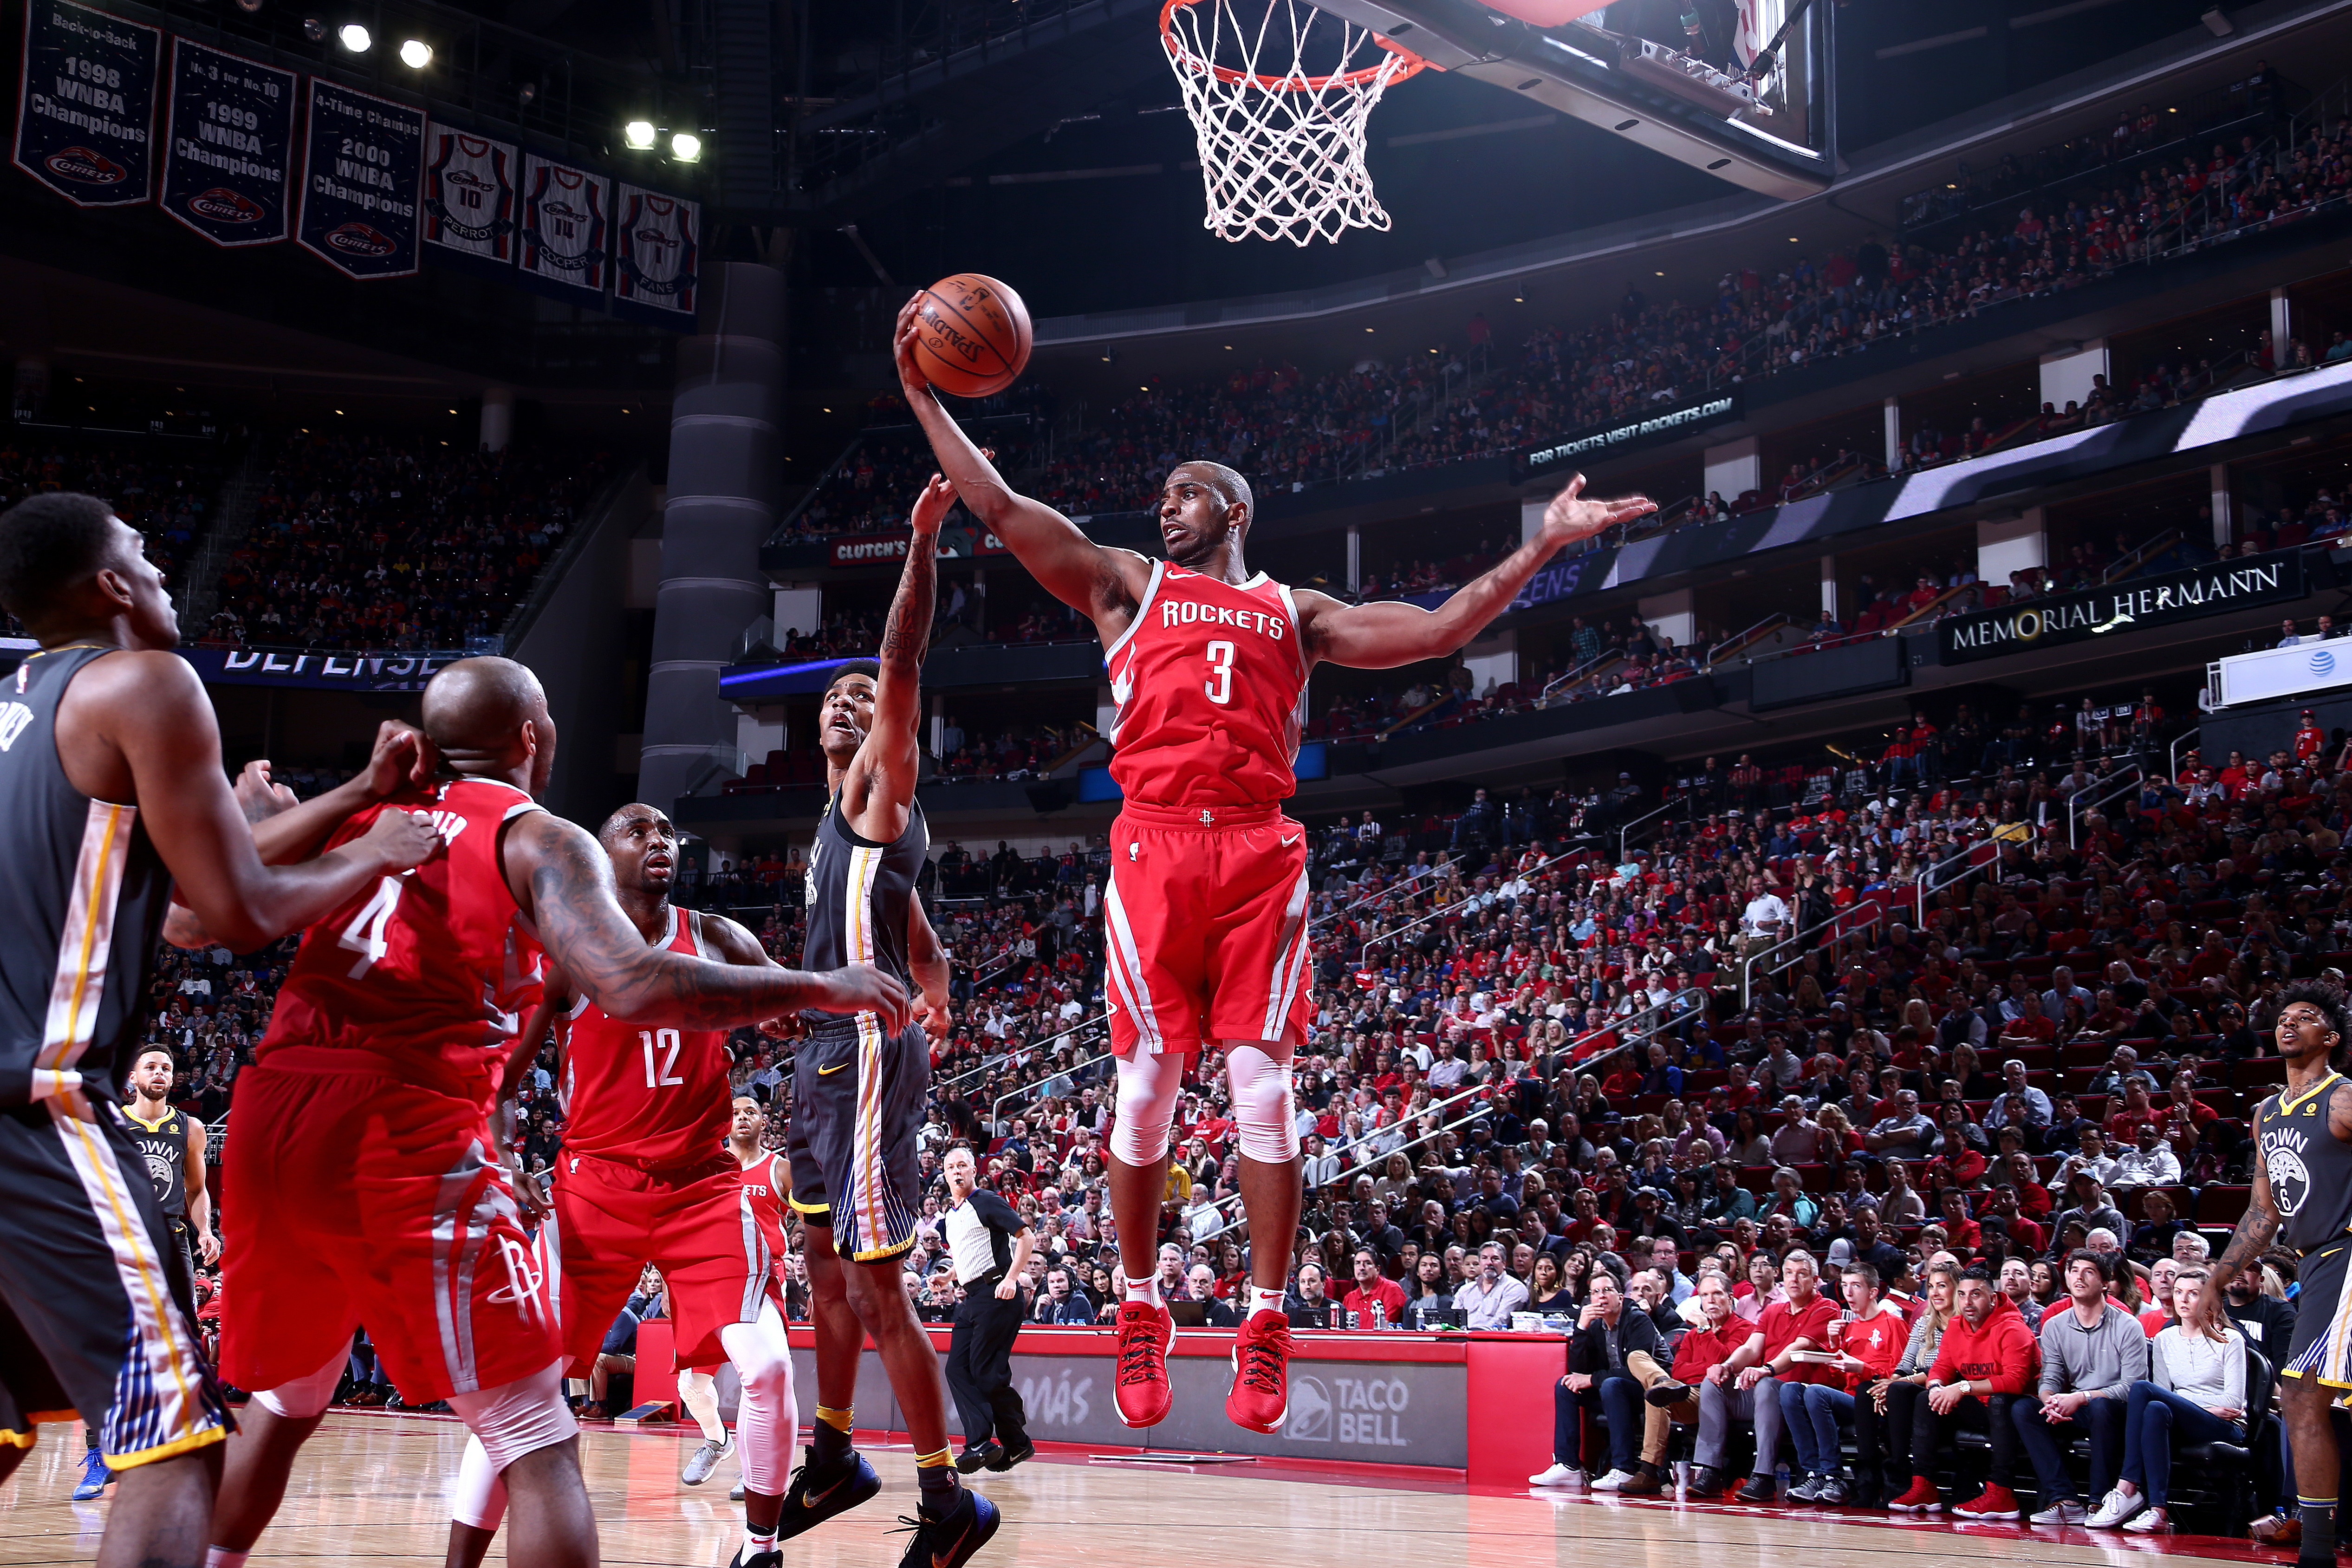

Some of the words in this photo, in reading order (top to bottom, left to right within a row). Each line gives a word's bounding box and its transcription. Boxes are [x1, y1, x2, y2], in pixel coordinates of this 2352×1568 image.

[52, 13, 136, 50] Back-to-Back
[65, 56, 120, 88] 1998
[208, 65, 218, 81] 3
[223, 72, 239, 84] for
[244, 78, 261, 91] No.
[262, 82, 279, 98] 10
[56, 75, 125, 115] WNBA
[31, 93, 145, 142] Champions
[207, 101, 258, 130] 1999
[316, 94, 363, 119] 4-Time
[367, 110, 420, 136] Champs
[198, 120, 262, 156] WNBA
[342, 138, 390, 167] 2000
[175, 137, 282, 182] Champions
[335, 156, 394, 191] WNBA
[313, 174, 414, 217] Champions
[460, 187, 481, 209] 10
[442, 216, 494, 239] PERROT
[555, 219, 574, 240] 14
[539, 246, 589, 268] COOPER
[640, 278, 674, 293] FANS
[917, 299, 985, 363] SPALDING
[1530, 449, 1554, 466] FOR
[1554, 433, 1606, 458] TICKETS
[1606, 424, 1640, 444] VISIT
[1639, 397, 1733, 435] ROCKETS.COM
[837, 540, 907, 560] CLUTCH'S
[1159, 599, 1285, 640] ROCKETS
[1953, 603, 2102, 650] MEMORIAL
[1205, 640, 1235, 704] 3
[337, 868, 416, 981] 4
[638, 1028, 684, 1088] 12
[2260, 1126, 2309, 1159] TOWN
[2279, 1187, 2292, 1211] 6
[1021, 1369, 1093, 1426] MÁS
[1334, 1377, 1409, 1412] TACO
[1339, 1411, 1408, 1447] BELL
